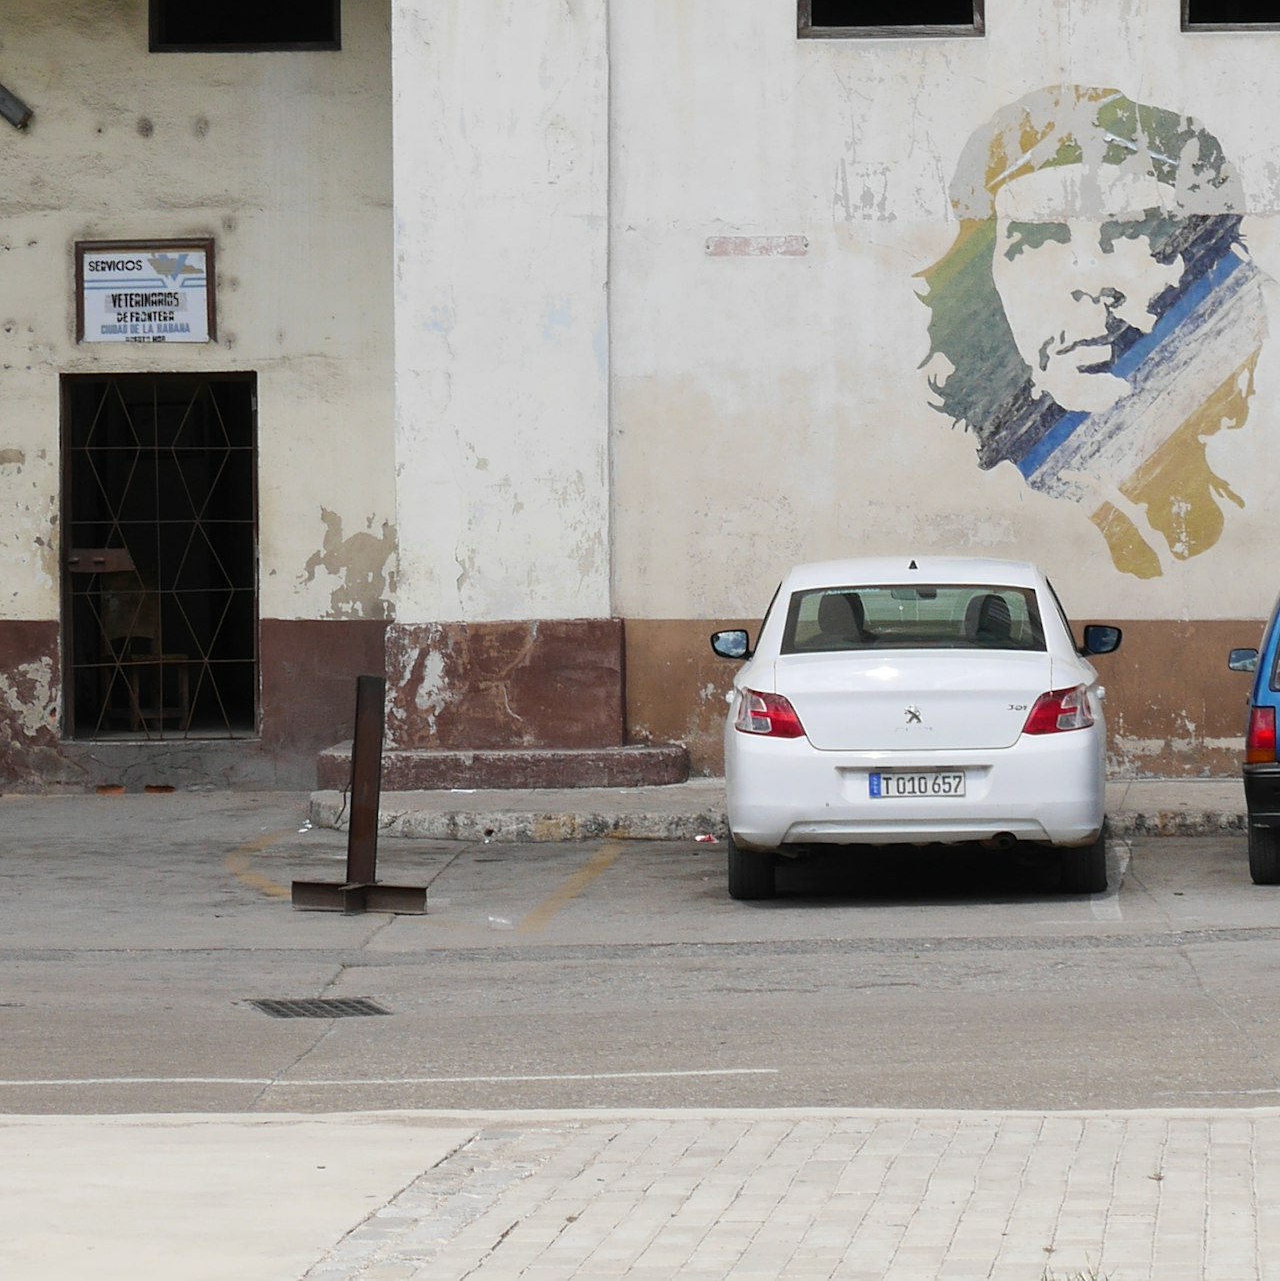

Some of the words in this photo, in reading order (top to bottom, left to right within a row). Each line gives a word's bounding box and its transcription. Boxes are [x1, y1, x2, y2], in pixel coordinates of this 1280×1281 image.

[88, 260, 143, 272] SERVICIOS
[111, 292, 180, 308] VETERINARIOS
[117, 312, 129, 323] DE
[130, 310, 175, 323] FRONTERA
[142, 324, 154, 334] LA
